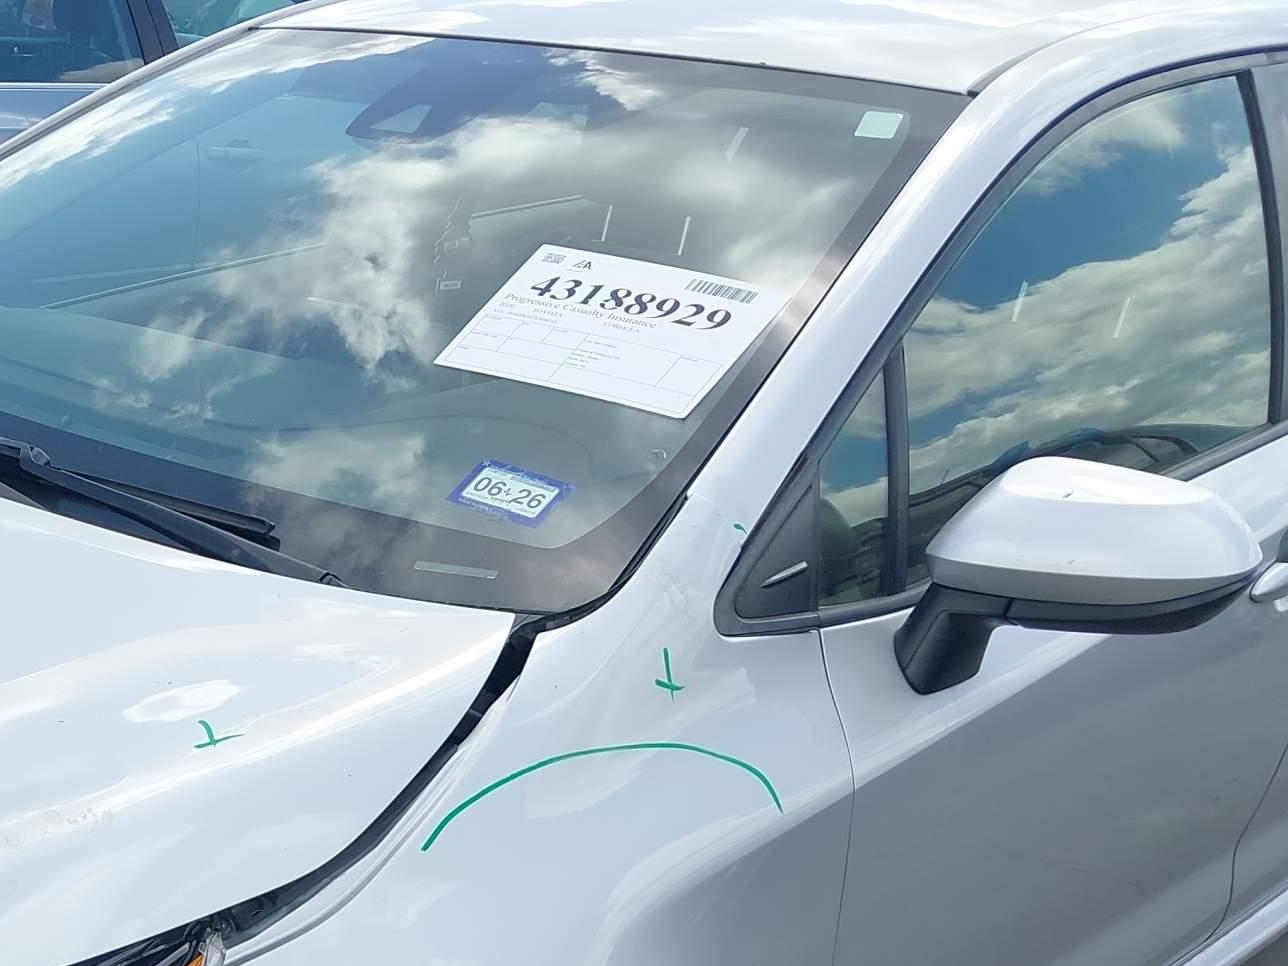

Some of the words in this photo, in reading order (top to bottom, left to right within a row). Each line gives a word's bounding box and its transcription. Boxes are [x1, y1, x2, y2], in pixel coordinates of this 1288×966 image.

[505, 293, 561, 309] Progressive
[562, 304, 606, 319] Casualty
[607, 312, 657, 329] Insurance
[530, 276, 732, 330] 43188929
[473, 477, 507, 496] 06
[511, 489, 546, 509] 26
